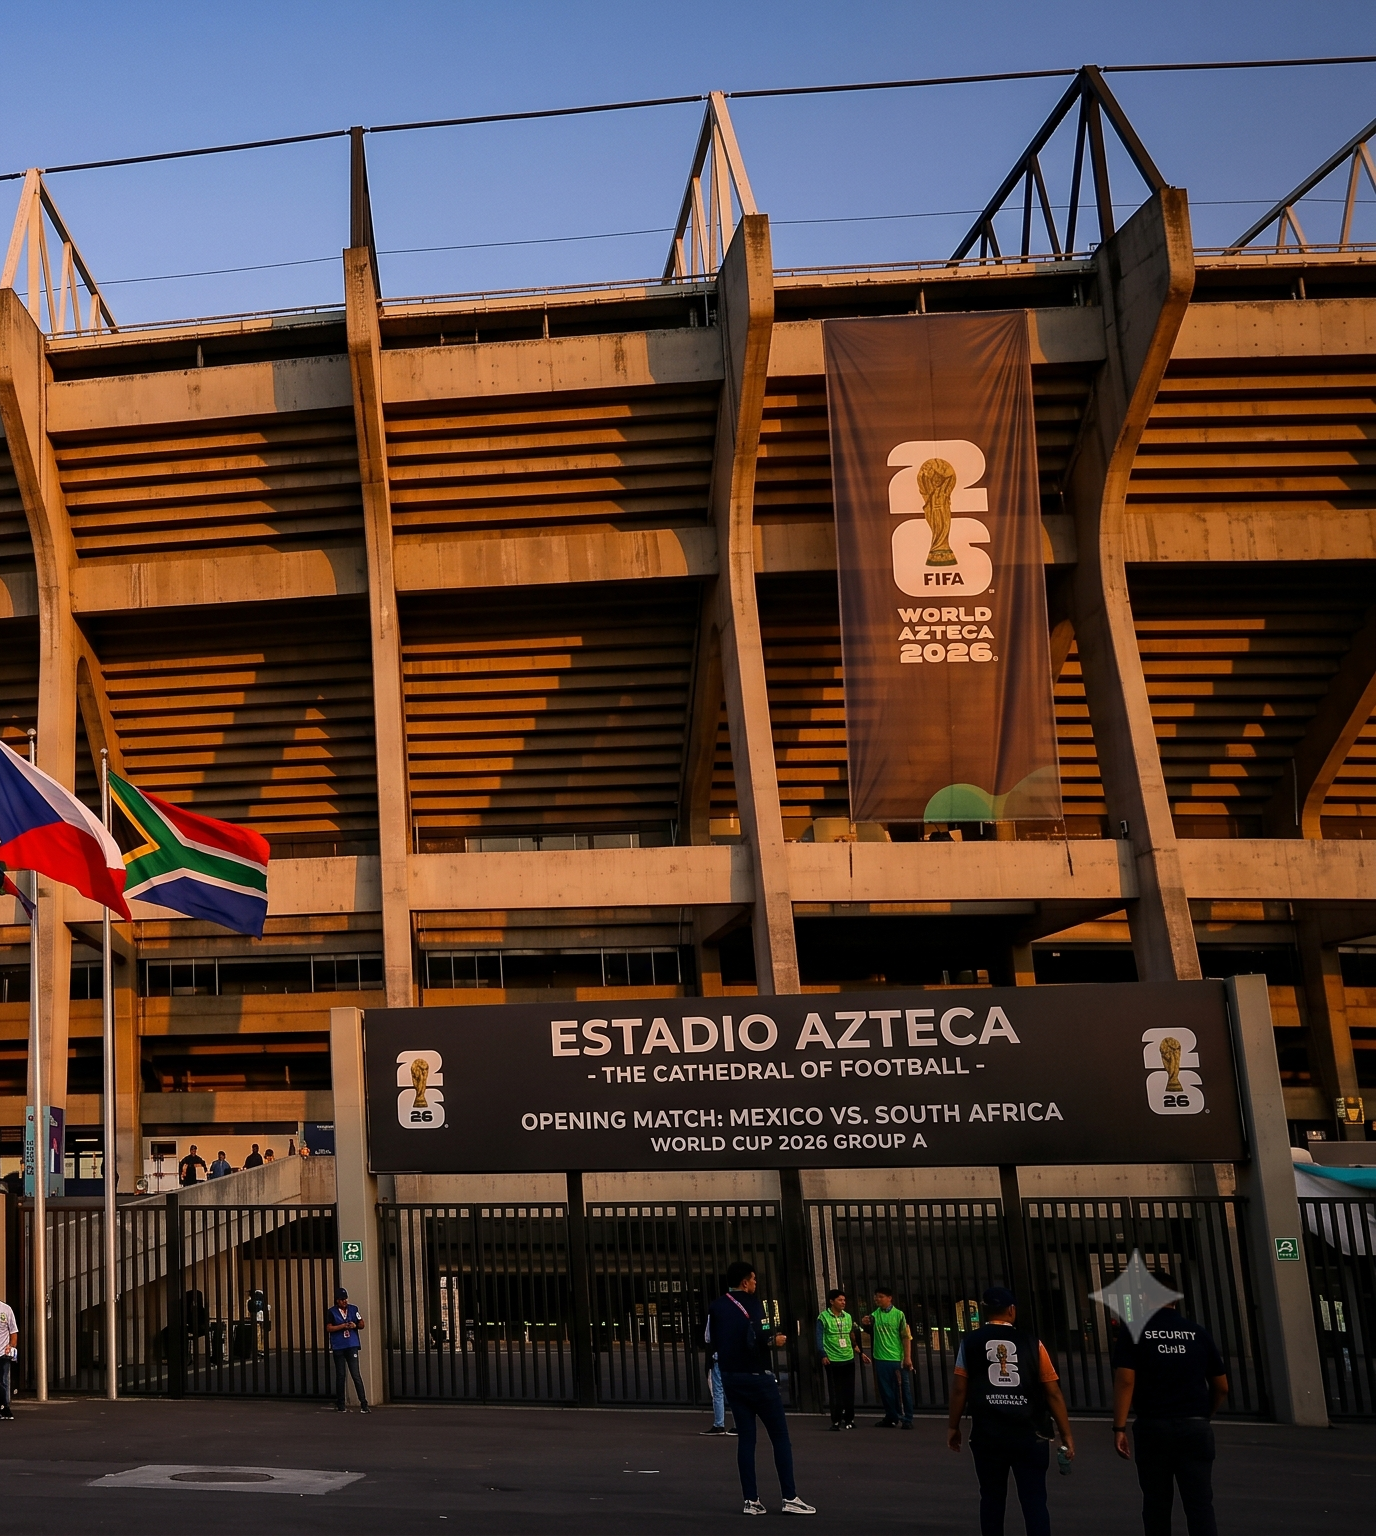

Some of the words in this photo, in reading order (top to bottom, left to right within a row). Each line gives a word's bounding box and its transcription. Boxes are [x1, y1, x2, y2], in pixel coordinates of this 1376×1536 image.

[924, 572, 964, 586] FIFA
[897, 606, 992, 623] WORLD
[897, 625, 994, 641] AZTECA
[550, 1013, 779, 1058] ESTADIO
[795, 1005, 1021, 1050] AZTECA
[601, 1065, 647, 1084] THE
[653, 1061, 795, 1083] CATHEDRAL
[800, 1060, 833, 1079] OF
[840, 1056, 970, 1077] FOOTBALL
[1163, 1095, 1190, 1108] 26
[410, 1110, 433, 1122] 26
[521, 1110, 626, 1131] OPENING
[633, 1108, 724, 1129] MATCH:
[729, 1106, 824, 1127] MEXICO
[829, 1105, 869, 1125] VS.
[875, 1104, 961, 1124] SOUTH
[968, 1101, 1064, 1122] AFRICA
[650, 1135, 726, 1152] WORLD
[732, 1135, 773, 1151] CUP
[778, 1134, 828, 1151] 2026
[833, 1133, 906, 1150] GROUP
[912, 1133, 928, 1149] A
[1144, 1330, 1196, 1341] SECURITY
